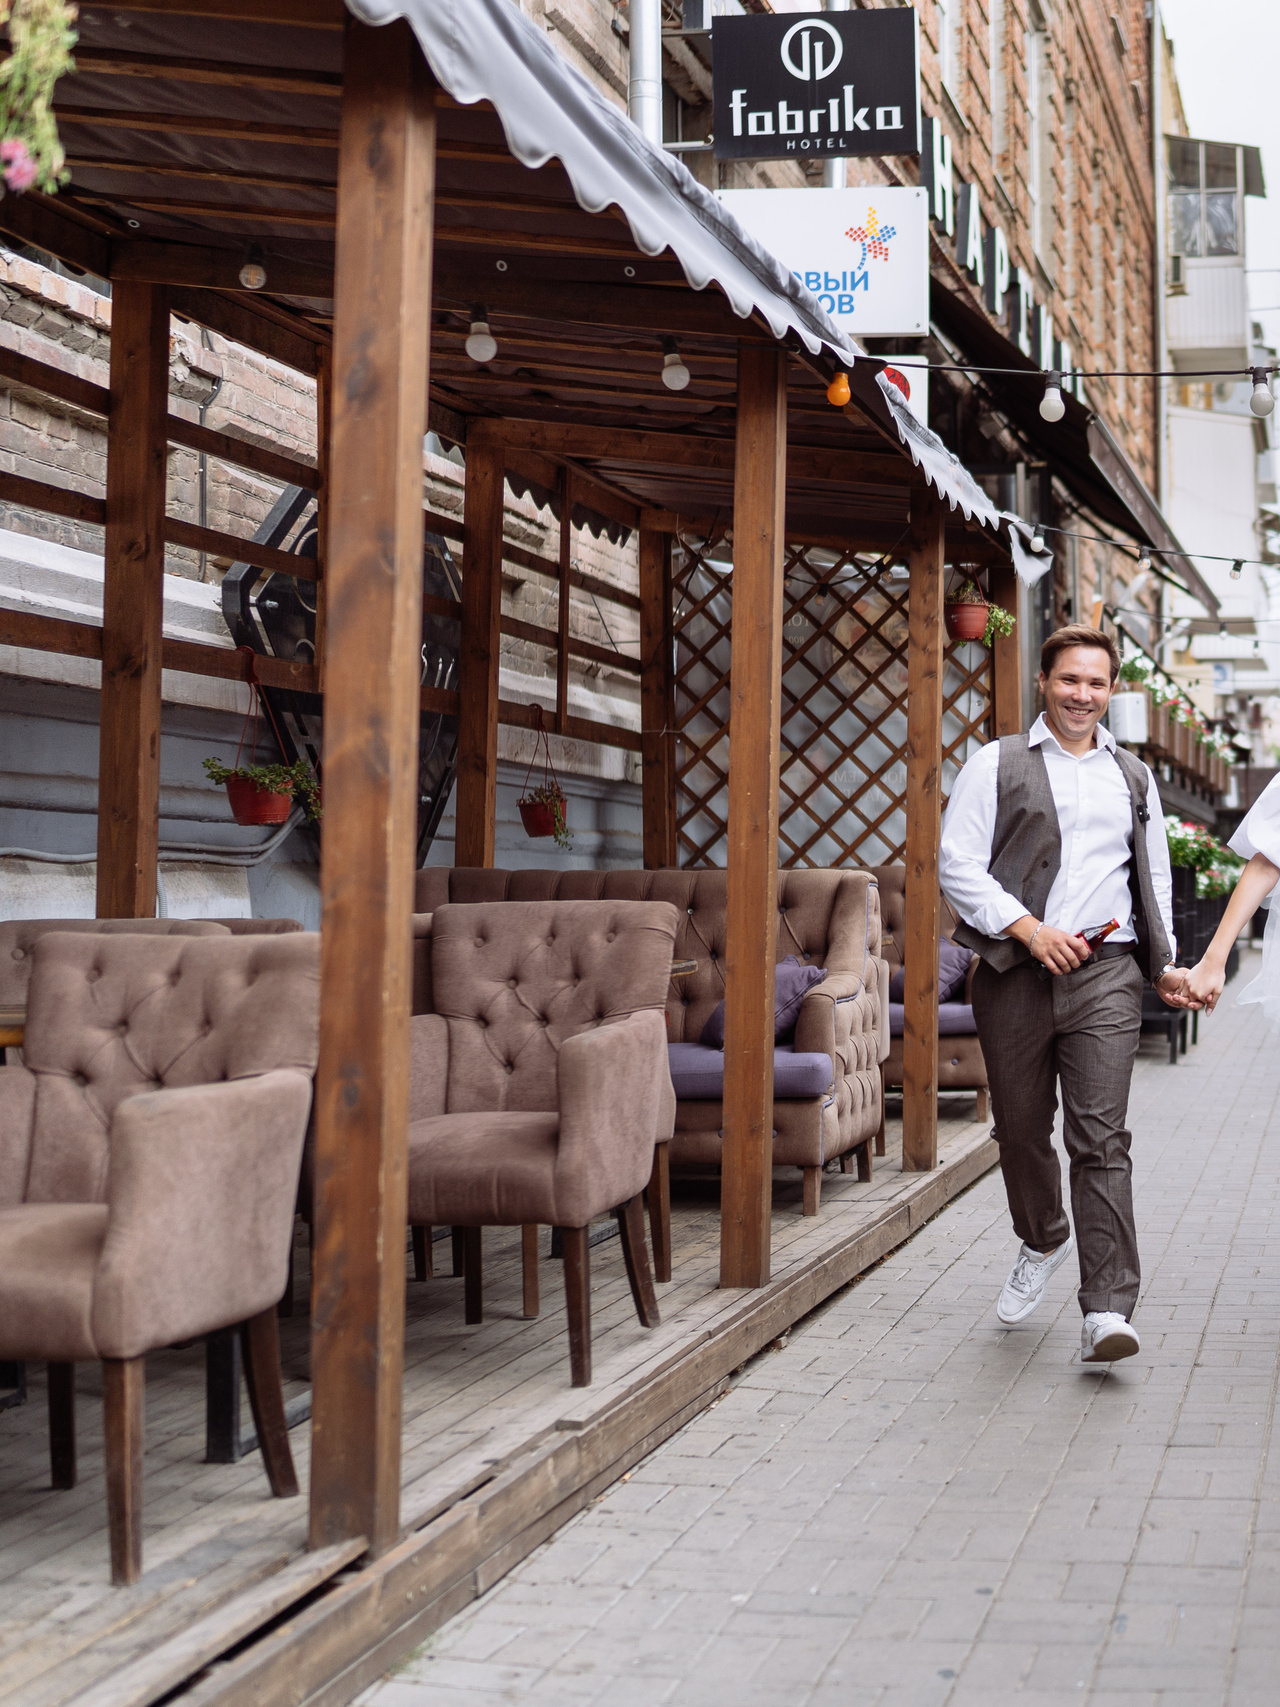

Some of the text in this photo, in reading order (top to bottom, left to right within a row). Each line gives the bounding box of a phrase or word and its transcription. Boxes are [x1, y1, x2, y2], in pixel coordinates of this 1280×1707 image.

[729, 85, 904, 136] fabrika
[786, 138, 847, 150] HOTEL
[817, 293, 855, 315] ОВ
